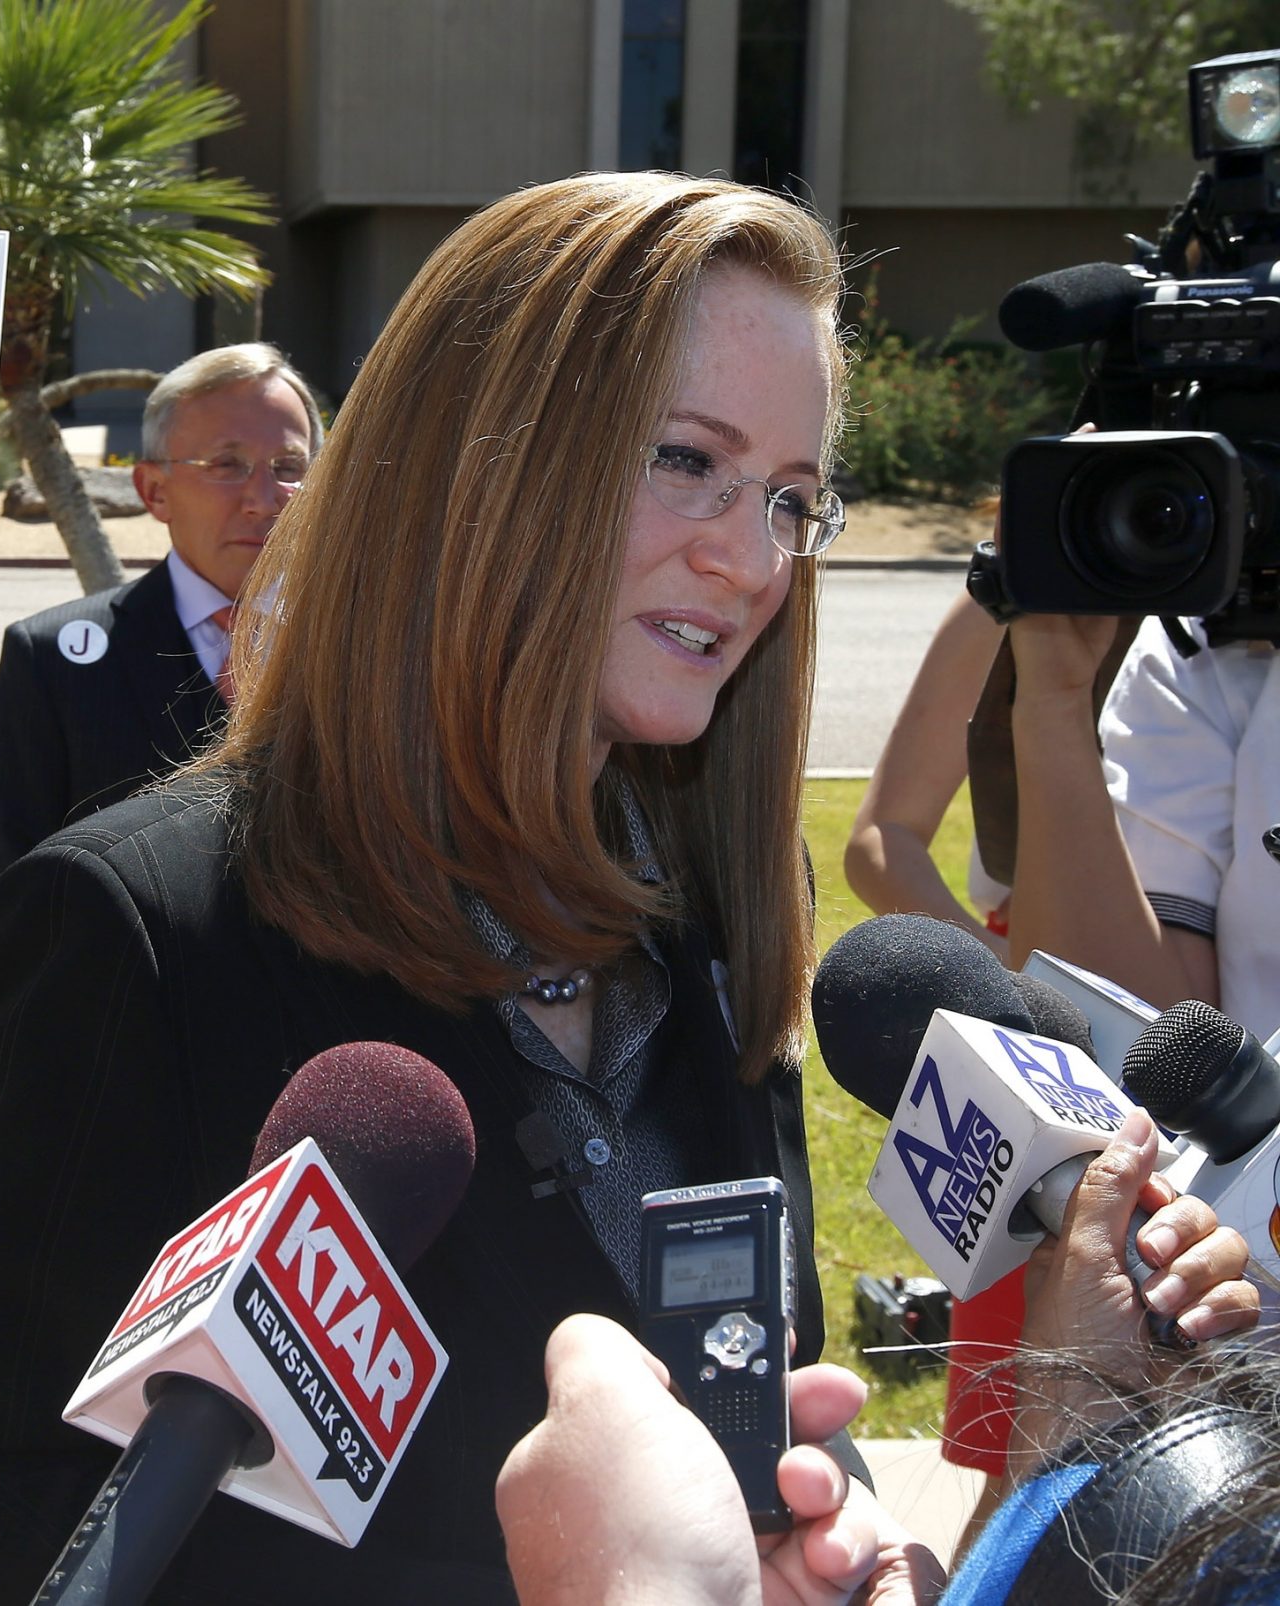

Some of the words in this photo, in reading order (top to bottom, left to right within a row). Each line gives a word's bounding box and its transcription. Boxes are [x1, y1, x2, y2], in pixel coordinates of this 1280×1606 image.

[1187, 285, 1254, 297] Panasonic
[69, 627, 89, 656] J
[993, 1028, 1108, 1098] AZ
[1030, 1079, 1126, 1121] NEWS
[1049, 1104, 1124, 1132] RADI
[893, 1054, 979, 1220] AZ
[935, 1117, 996, 1239] NEWS
[954, 1138, 1014, 1264] RADIO
[129, 1186, 268, 1319] KTAR
[275, 1194, 415, 1433] KTAR
[336, 1426, 375, 1484] 92.3
